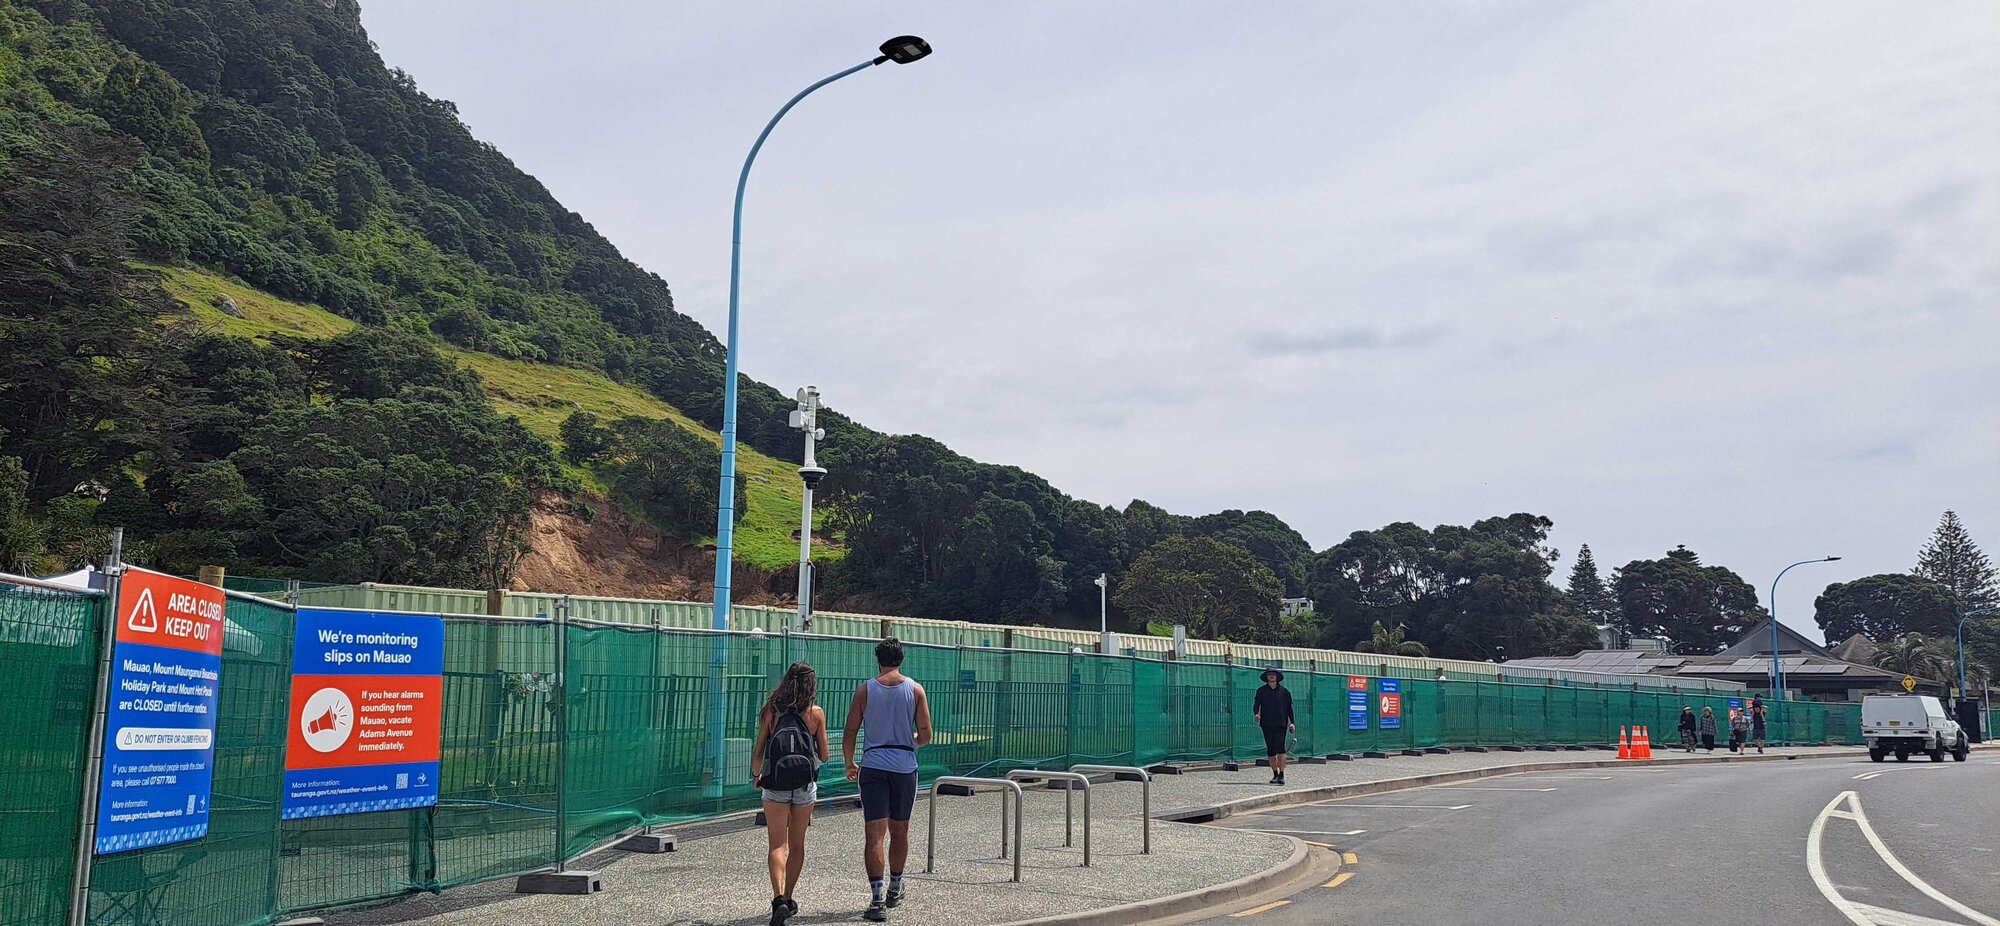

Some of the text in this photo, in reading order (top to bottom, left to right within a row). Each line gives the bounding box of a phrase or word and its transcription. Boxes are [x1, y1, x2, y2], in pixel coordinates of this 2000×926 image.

[168, 593, 222, 622] AREA CLOSED
[165, 616, 210, 640] KEEP OUT
[356, 632, 418, 648] monitoring
[324, 649, 412, 666] slips on Mauao
[124, 659, 152, 676] Mauao,
[153, 662, 174, 676] Mount
[122, 678, 150, 694] Holiday
[151, 681, 167, 693] Park
[167, 684, 179, 694] and
[179, 684, 195, 696] Mount
[362, 690, 424, 700] If you hear alarms
[119, 701, 132, 710] are
[134, 699, 164, 712] CLOSED
[360, 702, 412, 714] sounding from
[360, 716, 388, 726] Mauao,
[134, 734, 144, 744] DO
[144, 734, 157, 744] NOT
[157, 734, 173, 744] ENTER
[360, 730, 386, 738] Adams
[358, 742, 404, 752] immediately.
[112, 764, 118, 773] If
[117, 766, 127, 776] you
[111, 780, 124, 788] area,
[124, 778, 141, 788] please
[141, 777, 150, 786] call
[112, 801, 124, 809] More
